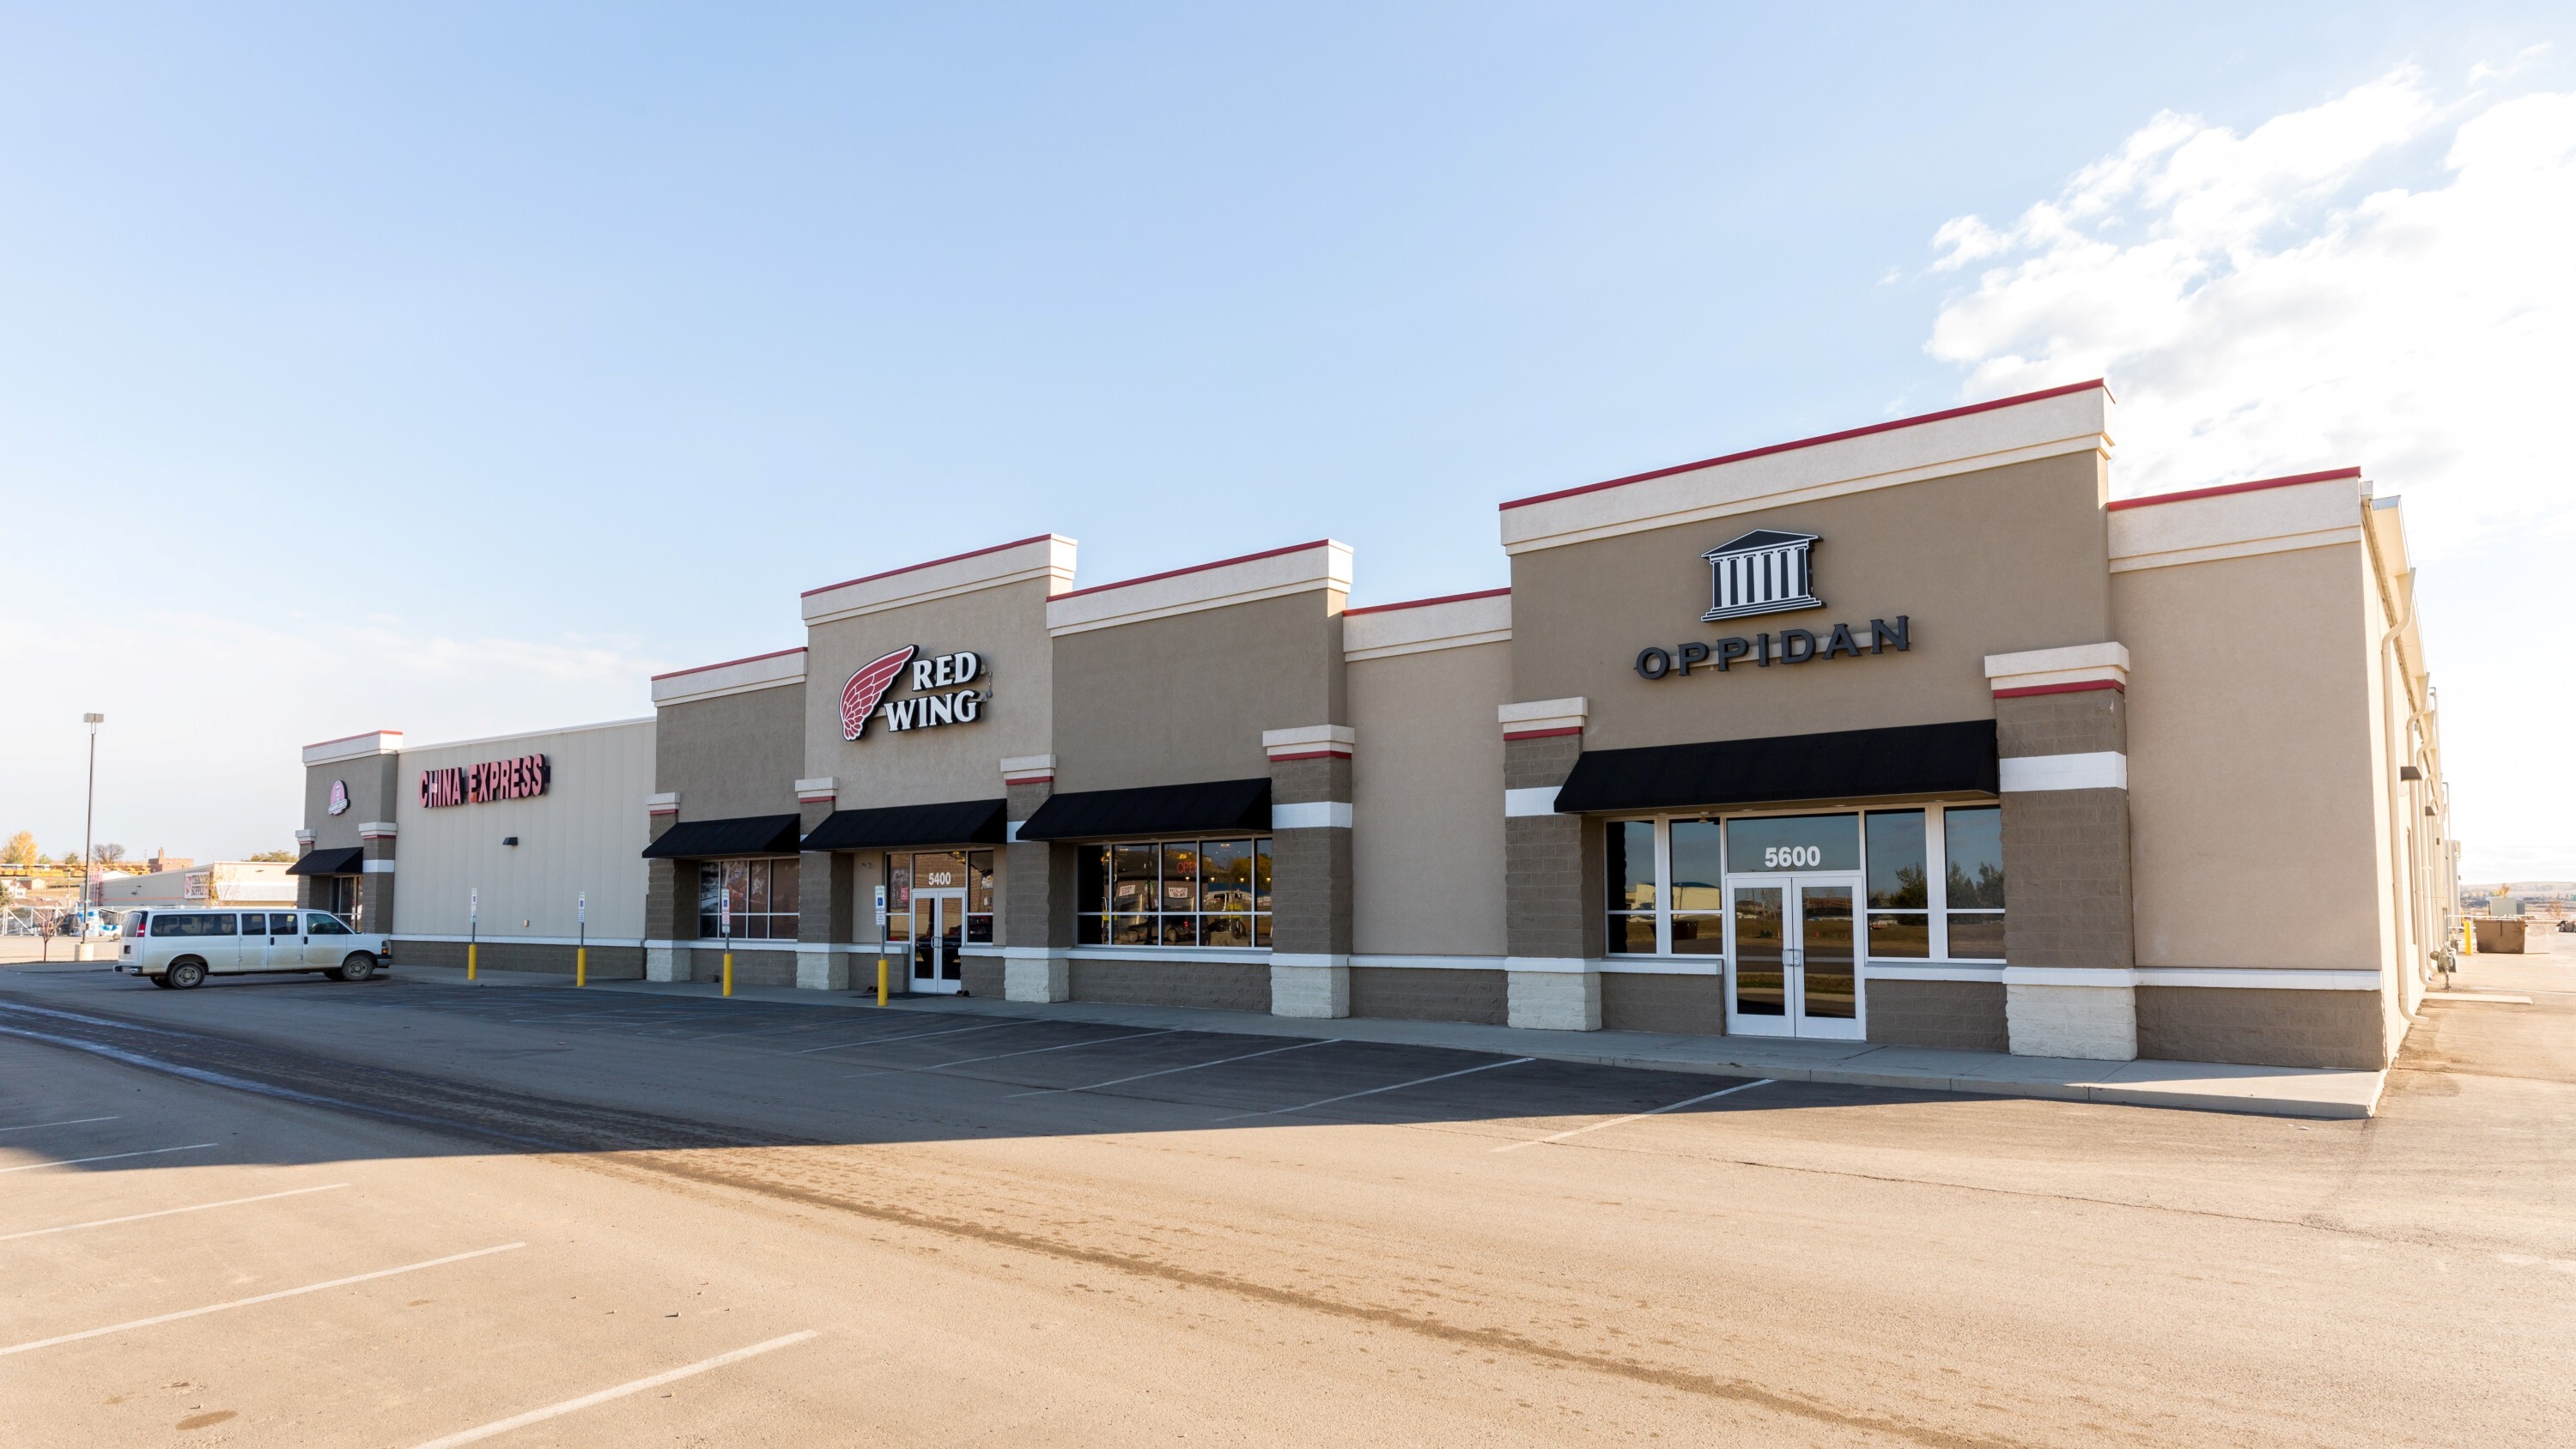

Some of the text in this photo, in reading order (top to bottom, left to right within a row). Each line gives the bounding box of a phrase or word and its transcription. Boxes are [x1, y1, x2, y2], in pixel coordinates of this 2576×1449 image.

[1636, 615, 1910, 680] OPPIDAN
[912, 652, 981, 691] RED
[884, 690, 981, 731] WING
[419, 754, 547, 808] CHINA EXPRESS
[1765, 846, 1821, 868] 5600
[928, 871, 951, 886] 5400
